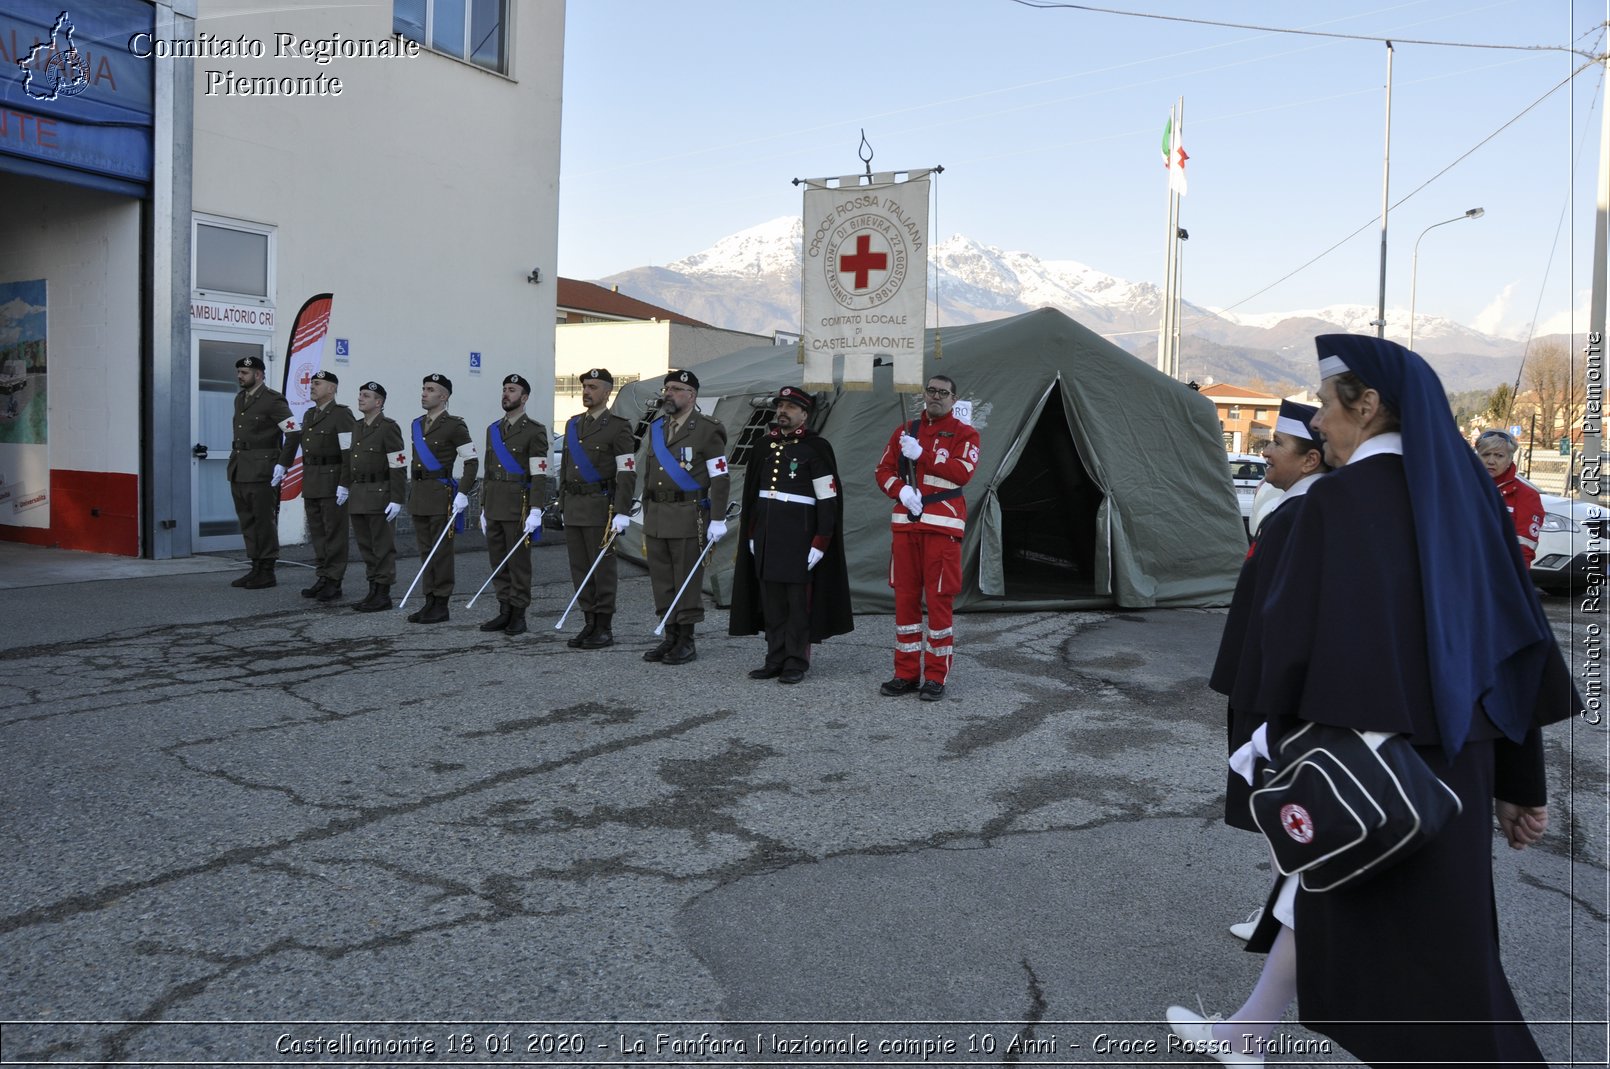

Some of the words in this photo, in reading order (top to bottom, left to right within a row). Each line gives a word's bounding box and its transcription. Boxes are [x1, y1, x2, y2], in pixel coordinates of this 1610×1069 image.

[808, 212, 836, 258] CROCE
[836, 196, 880, 219] ROSSA
[882, 198, 924, 253] ITALIANA
[836, 226, 848, 239] DI
[850, 216, 890, 234] GINEVRA
[889, 234, 899, 247] 22
[825, 241, 853, 306] CONVENZIONE
[891, 249, 905, 287] AGOSTO
[869, 286, 894, 305] 1864
[190, 304, 257, 325] AMBULATORIO
[259, 312, 274, 326] CRI
[821, 315, 862, 327] COMITATO
[865, 314, 907, 325] LOCALE
[813, 336, 915, 350] CASTELLAMONTE
